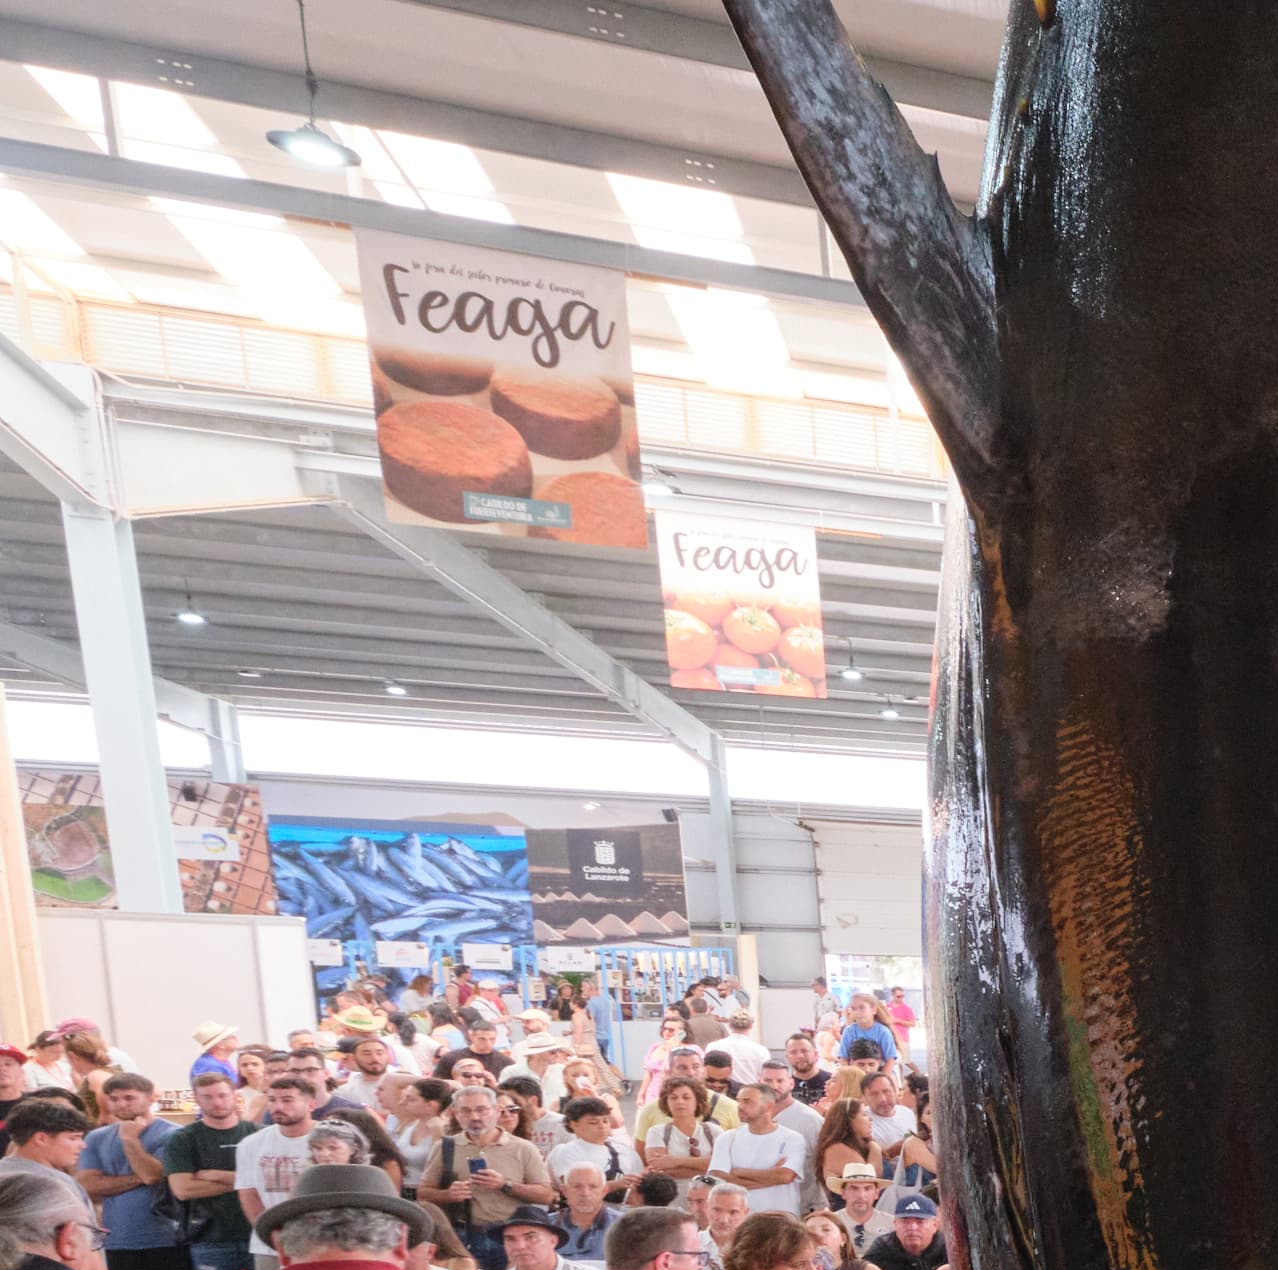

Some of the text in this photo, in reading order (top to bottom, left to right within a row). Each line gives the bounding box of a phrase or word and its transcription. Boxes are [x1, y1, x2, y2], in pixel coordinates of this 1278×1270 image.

[383, 263, 615, 369] Feaga
[673, 532, 808, 589] Feaga
[582, 865, 631, 875] Cabildo de
[584, 873, 630, 882] Lanzarote
